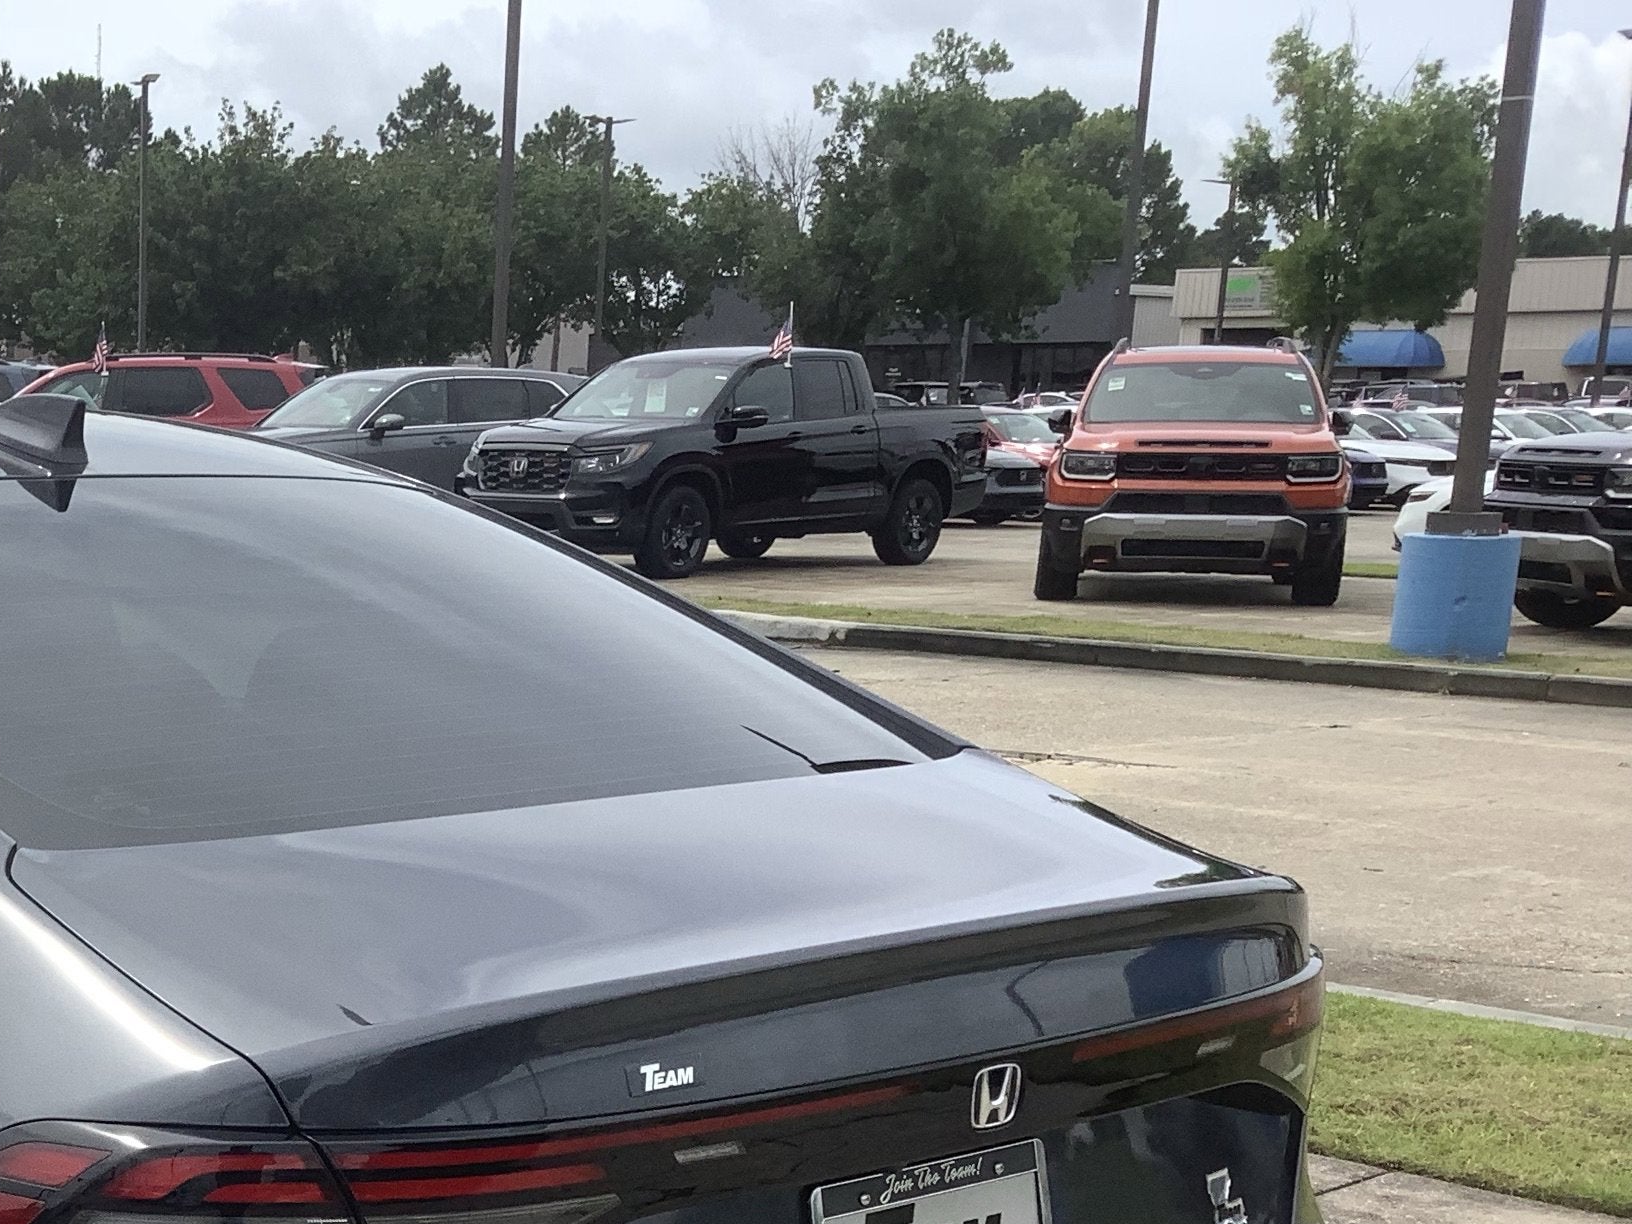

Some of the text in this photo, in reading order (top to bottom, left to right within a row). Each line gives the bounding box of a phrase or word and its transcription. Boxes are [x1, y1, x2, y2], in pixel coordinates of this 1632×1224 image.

[640, 1062, 694, 1092] TEAM
[880, 1158, 984, 1204] Join The Team!
